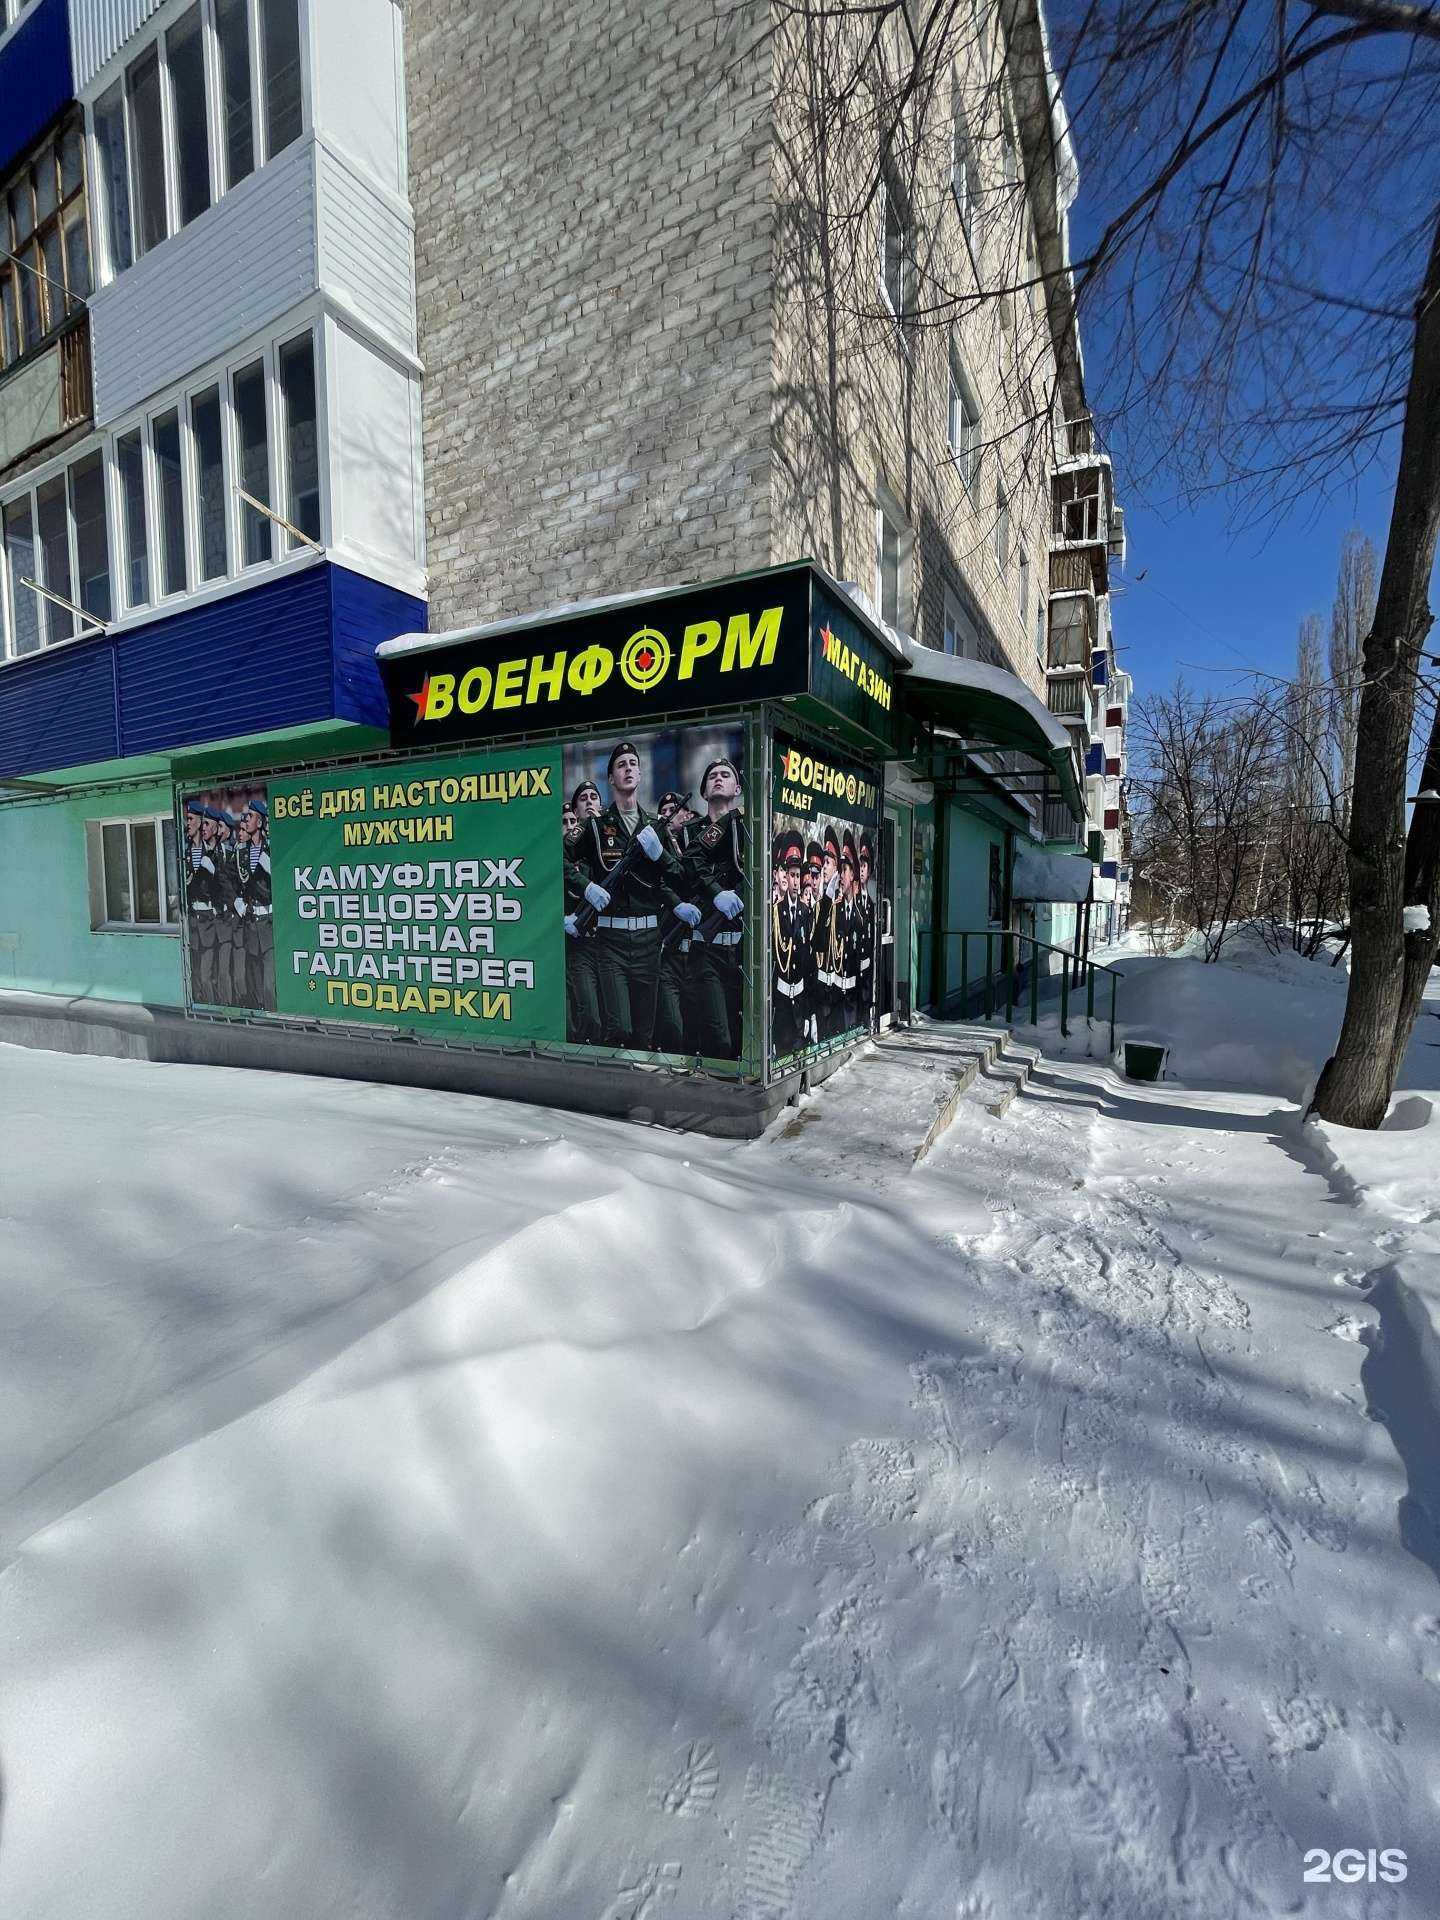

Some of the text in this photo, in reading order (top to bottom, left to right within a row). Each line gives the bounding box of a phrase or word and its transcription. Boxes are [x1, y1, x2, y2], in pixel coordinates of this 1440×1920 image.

[424, 606, 784, 720] ВОЕНФОРМ
[826, 630, 892, 711] МАГАЗИН
[274, 766, 552, 819] ВСЁ ДЛЯ НАСТОЯЩИХ
[787, 749, 876, 810] ВОЕНФОРМ
[782, 787, 813, 811] КАДЕТ
[343, 815, 454, 847] МУЖЧИН
[293, 858, 525, 891] КАМУФЛЯЖ
[297, 893, 523, 924] СПЕЦОБУВЬ
[318, 923, 496, 954] ВОЕННАЯ
[292, 951, 536, 989] ГАЛАНТЕРЕЯ
[326, 979, 513, 1021] ПОДАРКИ
